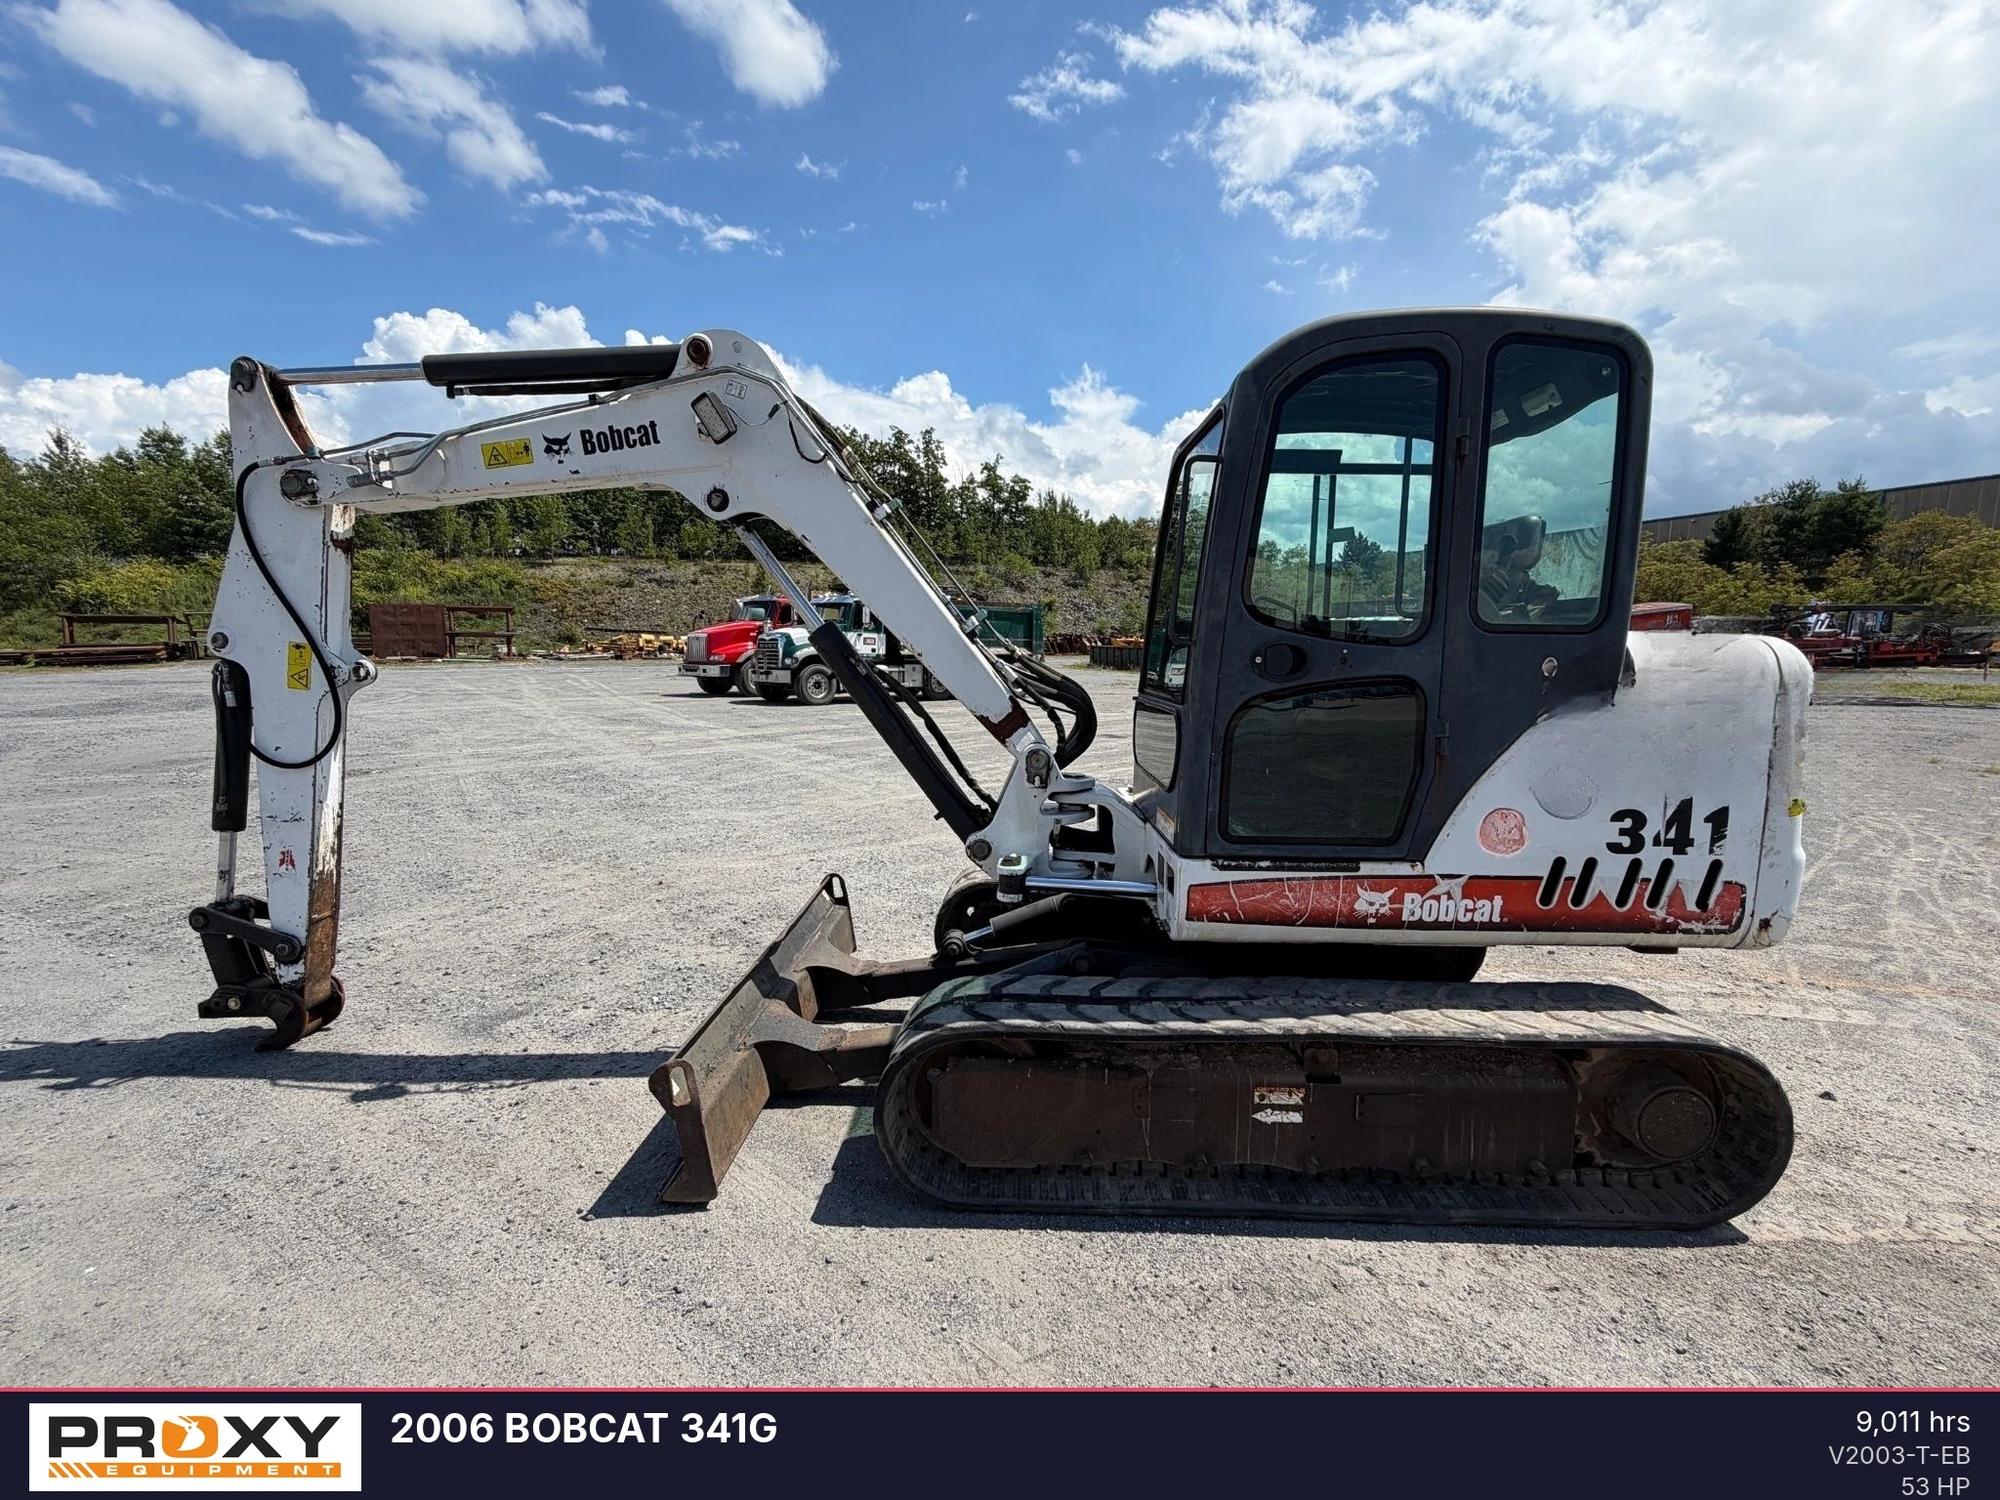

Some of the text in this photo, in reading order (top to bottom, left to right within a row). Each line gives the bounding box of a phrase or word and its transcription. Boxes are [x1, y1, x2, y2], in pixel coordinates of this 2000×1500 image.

[579, 420, 661, 456] Bobcat
[1605, 796, 1730, 856] 341
[1401, 892, 1504, 923] Bobcat
